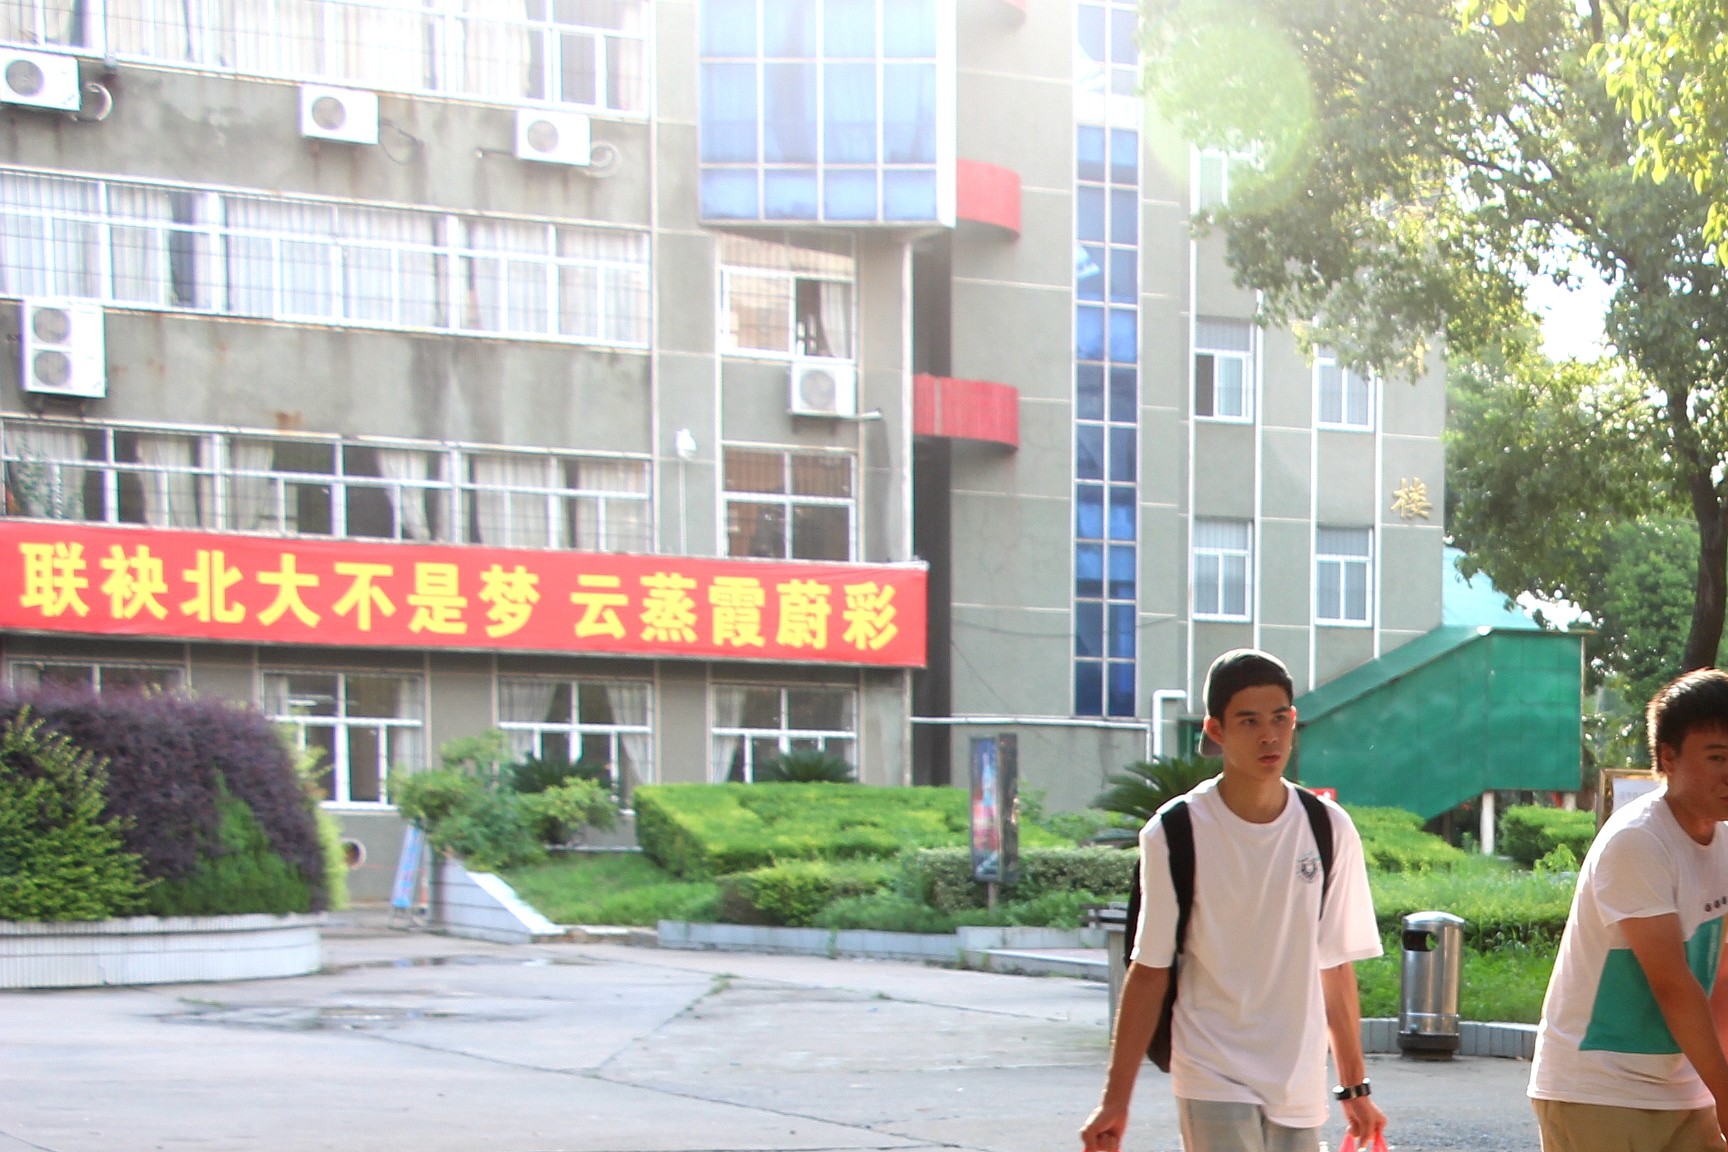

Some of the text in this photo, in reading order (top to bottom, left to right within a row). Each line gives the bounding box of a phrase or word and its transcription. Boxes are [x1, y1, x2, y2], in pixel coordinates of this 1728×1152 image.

[18, 541, 899, 650] 联袂北大不是梦 云蒸霞蔚彩
